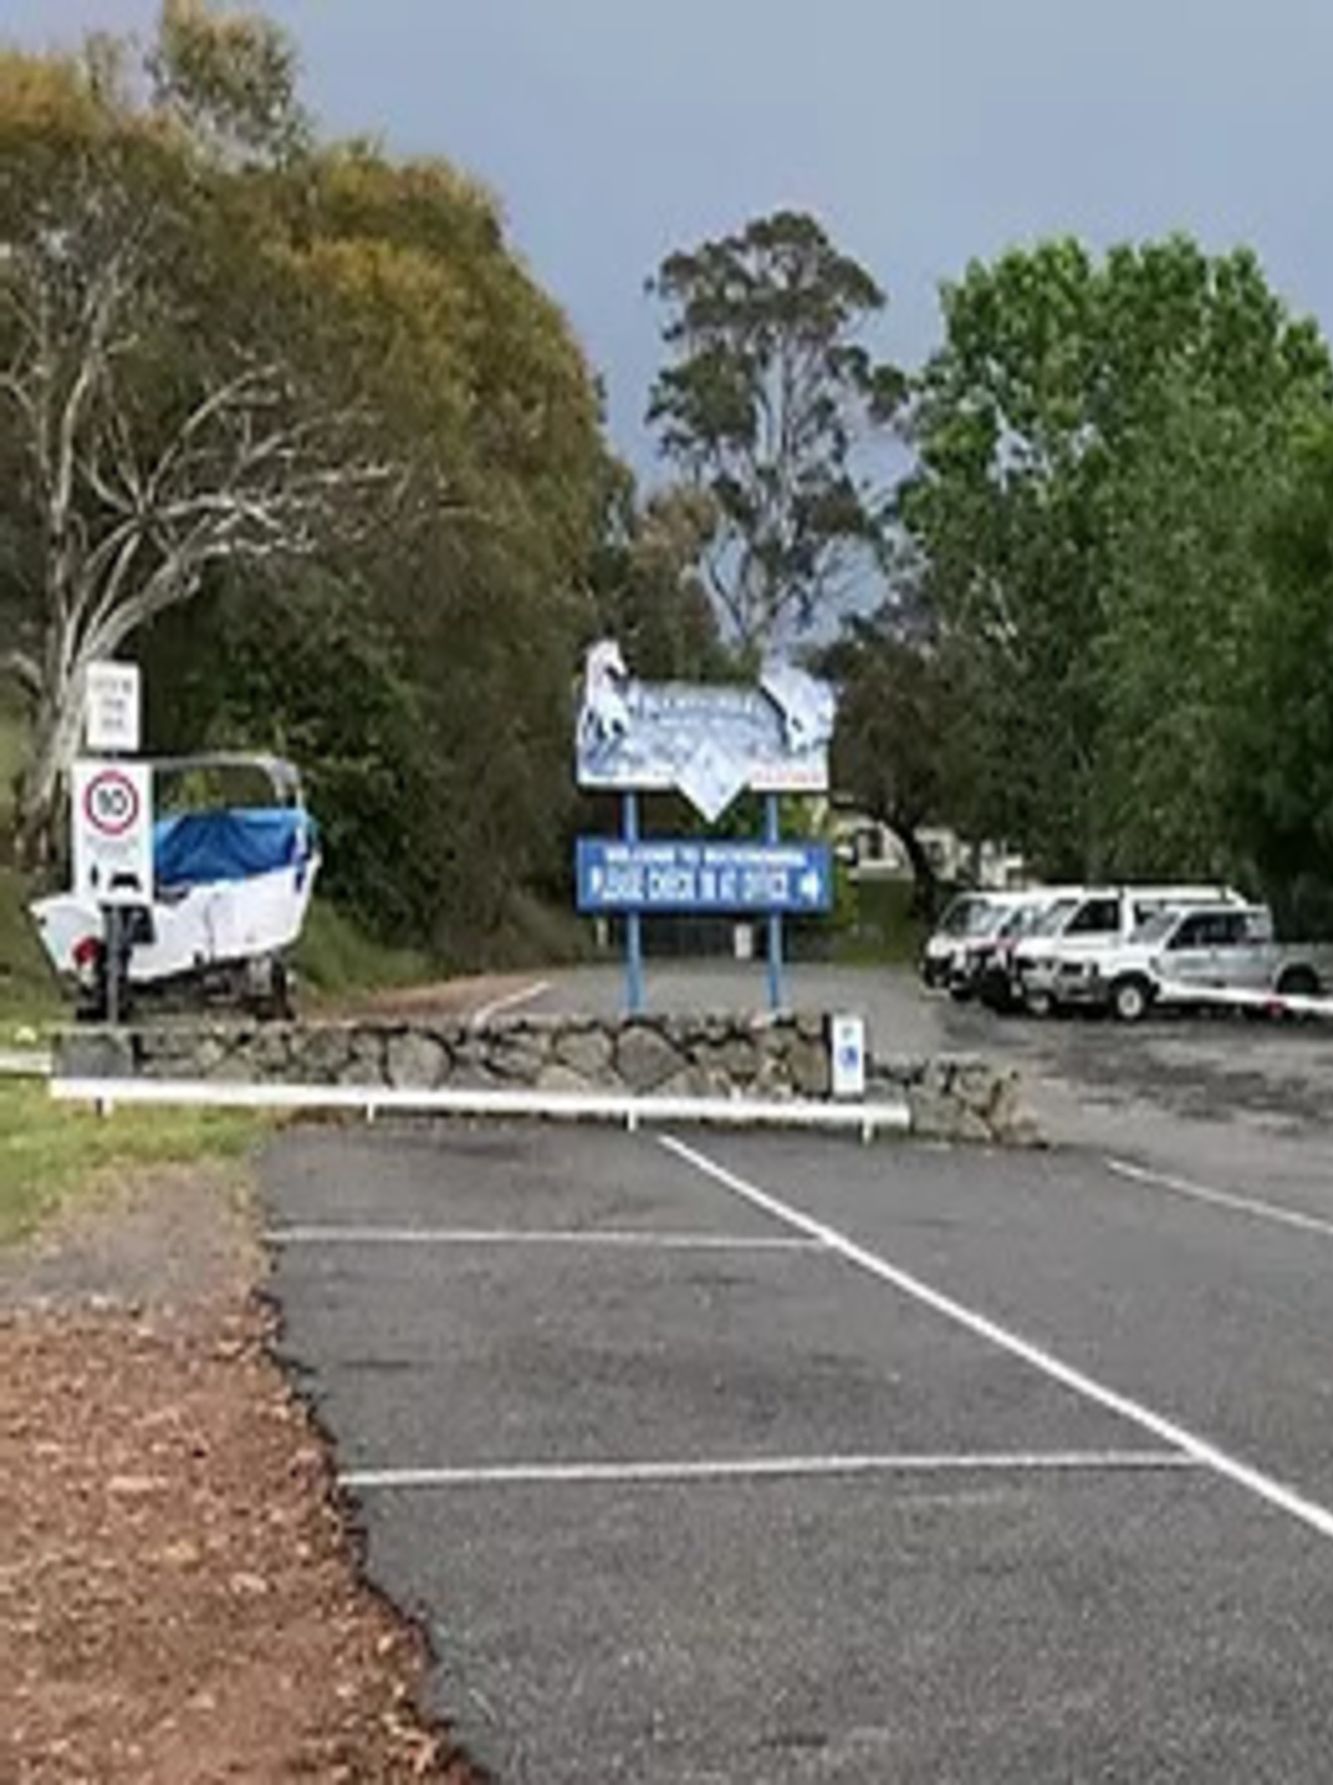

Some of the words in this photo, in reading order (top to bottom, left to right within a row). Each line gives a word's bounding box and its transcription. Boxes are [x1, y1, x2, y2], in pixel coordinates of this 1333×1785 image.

[97, 788, 128, 817] 10
[590, 866, 645, 901] PLEASE
[649, 869, 697, 901] CHECK
